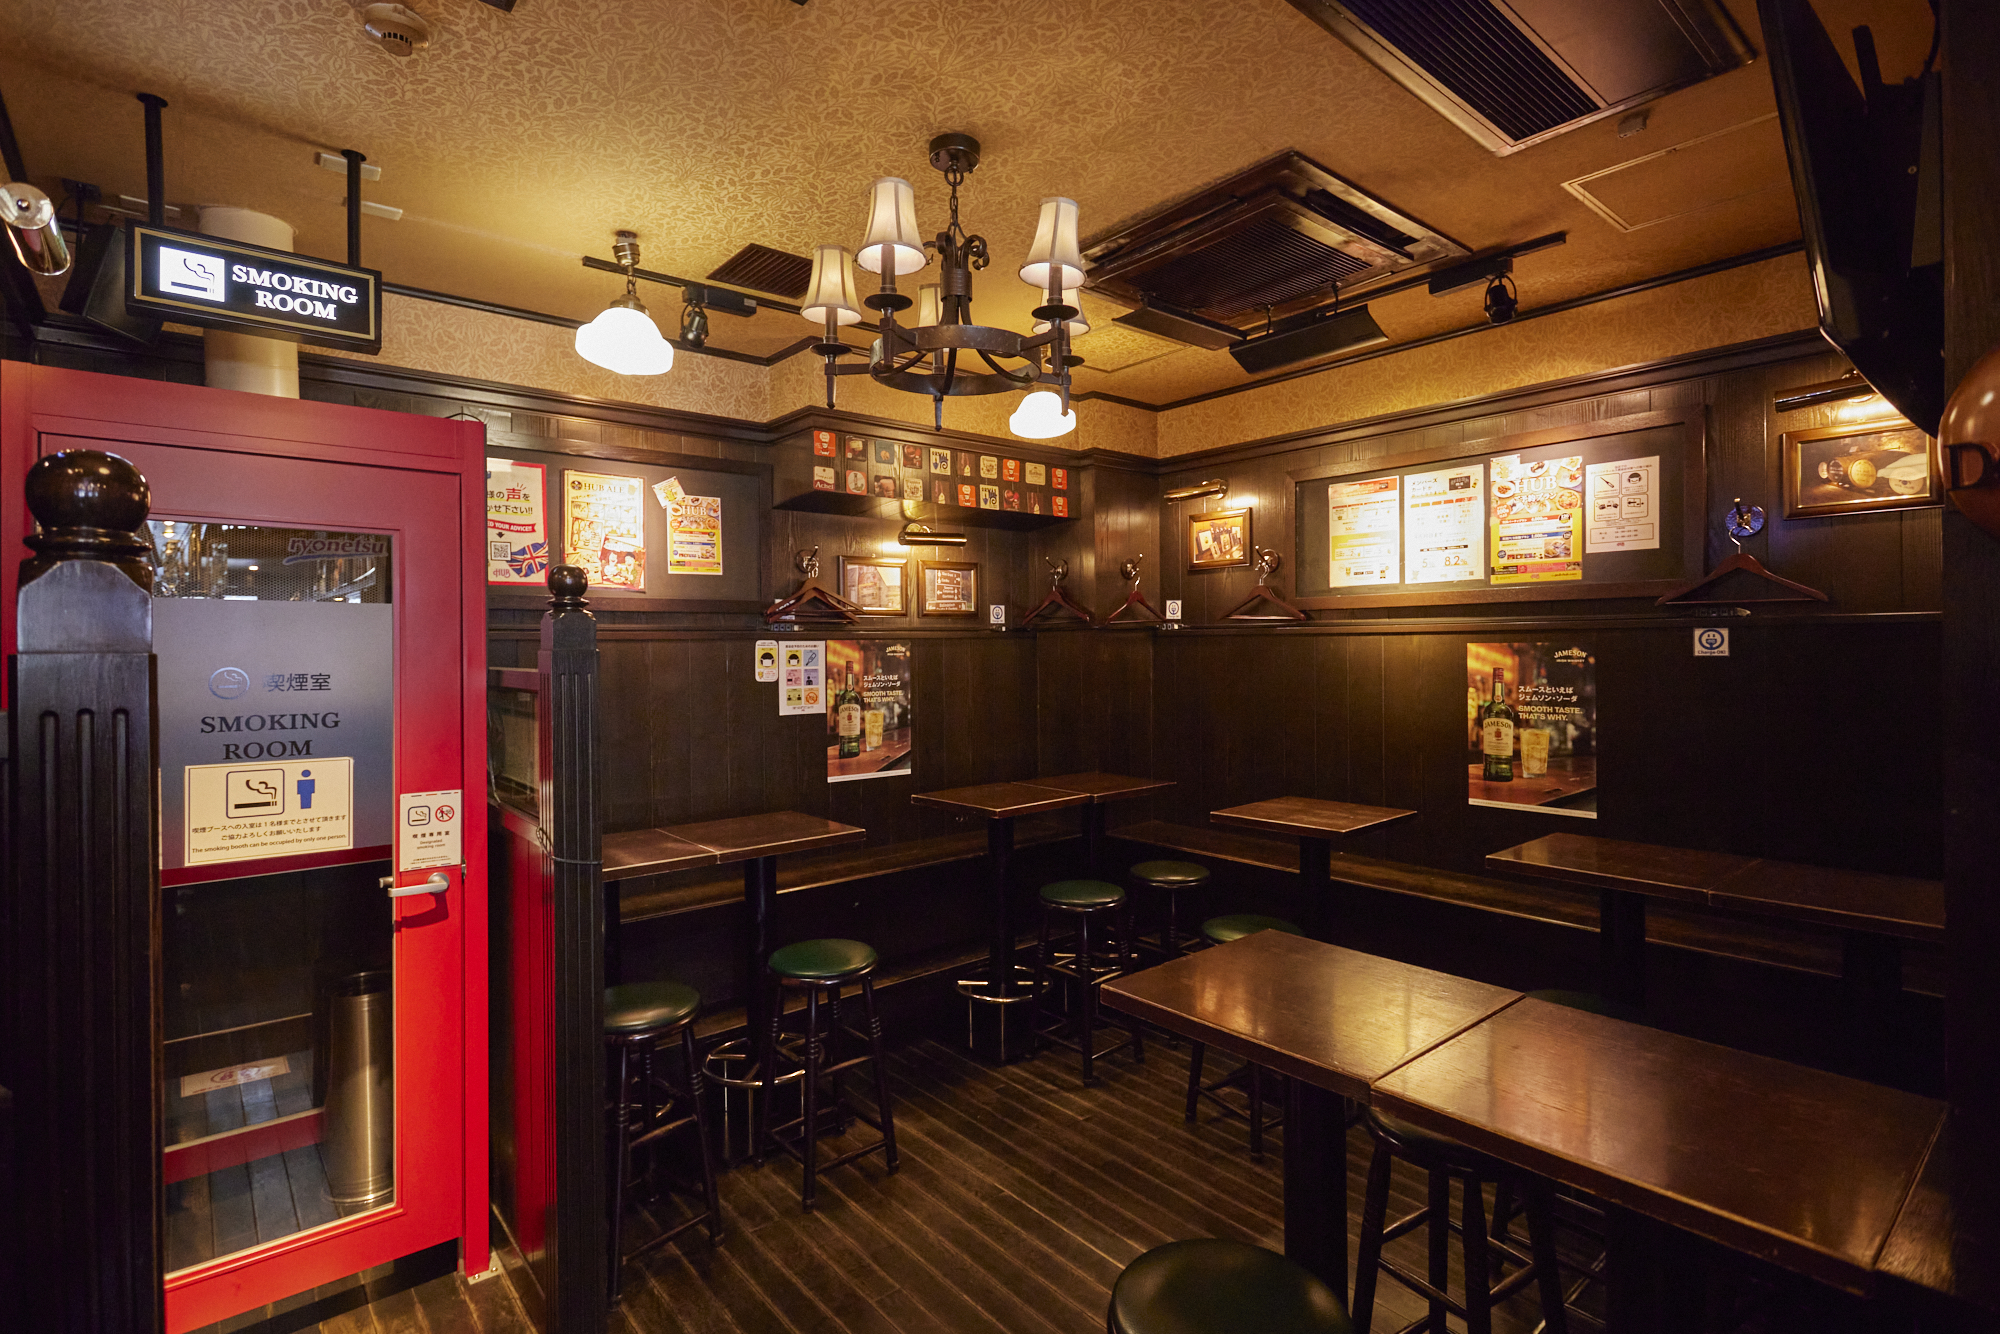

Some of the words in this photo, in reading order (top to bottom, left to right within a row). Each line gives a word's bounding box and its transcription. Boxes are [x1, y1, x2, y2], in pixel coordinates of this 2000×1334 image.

[232, 264, 358, 303] SMOKING
[255, 290, 337, 320] ROOM
[583, 482, 605, 491] HUB
[1515, 476, 1557, 493] HUB
[682, 505, 707, 515] HUB
[495, 522, 509, 530] YOUR
[289, 538, 385, 555] ryonetsu
[1554, 649, 1588, 658] JAMESON
[263, 672, 331, 692] 喫煙室
[1518, 685, 1574, 694] スムースといえば
[1518, 694, 1578, 702] ジェムソン・ソーダ
[1518, 705, 1553, 713] SMOOTH
[1554, 706, 1583, 714] TASTE.
[1518, 712, 1546, 720] THAT'S
[1547, 713, 1568, 721] WHY.
[200, 712, 341, 733] SMOKING
[1484, 720, 1512, 729] JAMESON
[222, 740, 313, 760] ROOM
[204, 844, 230, 853] smoking
[269, 838, 294, 847] occupied
